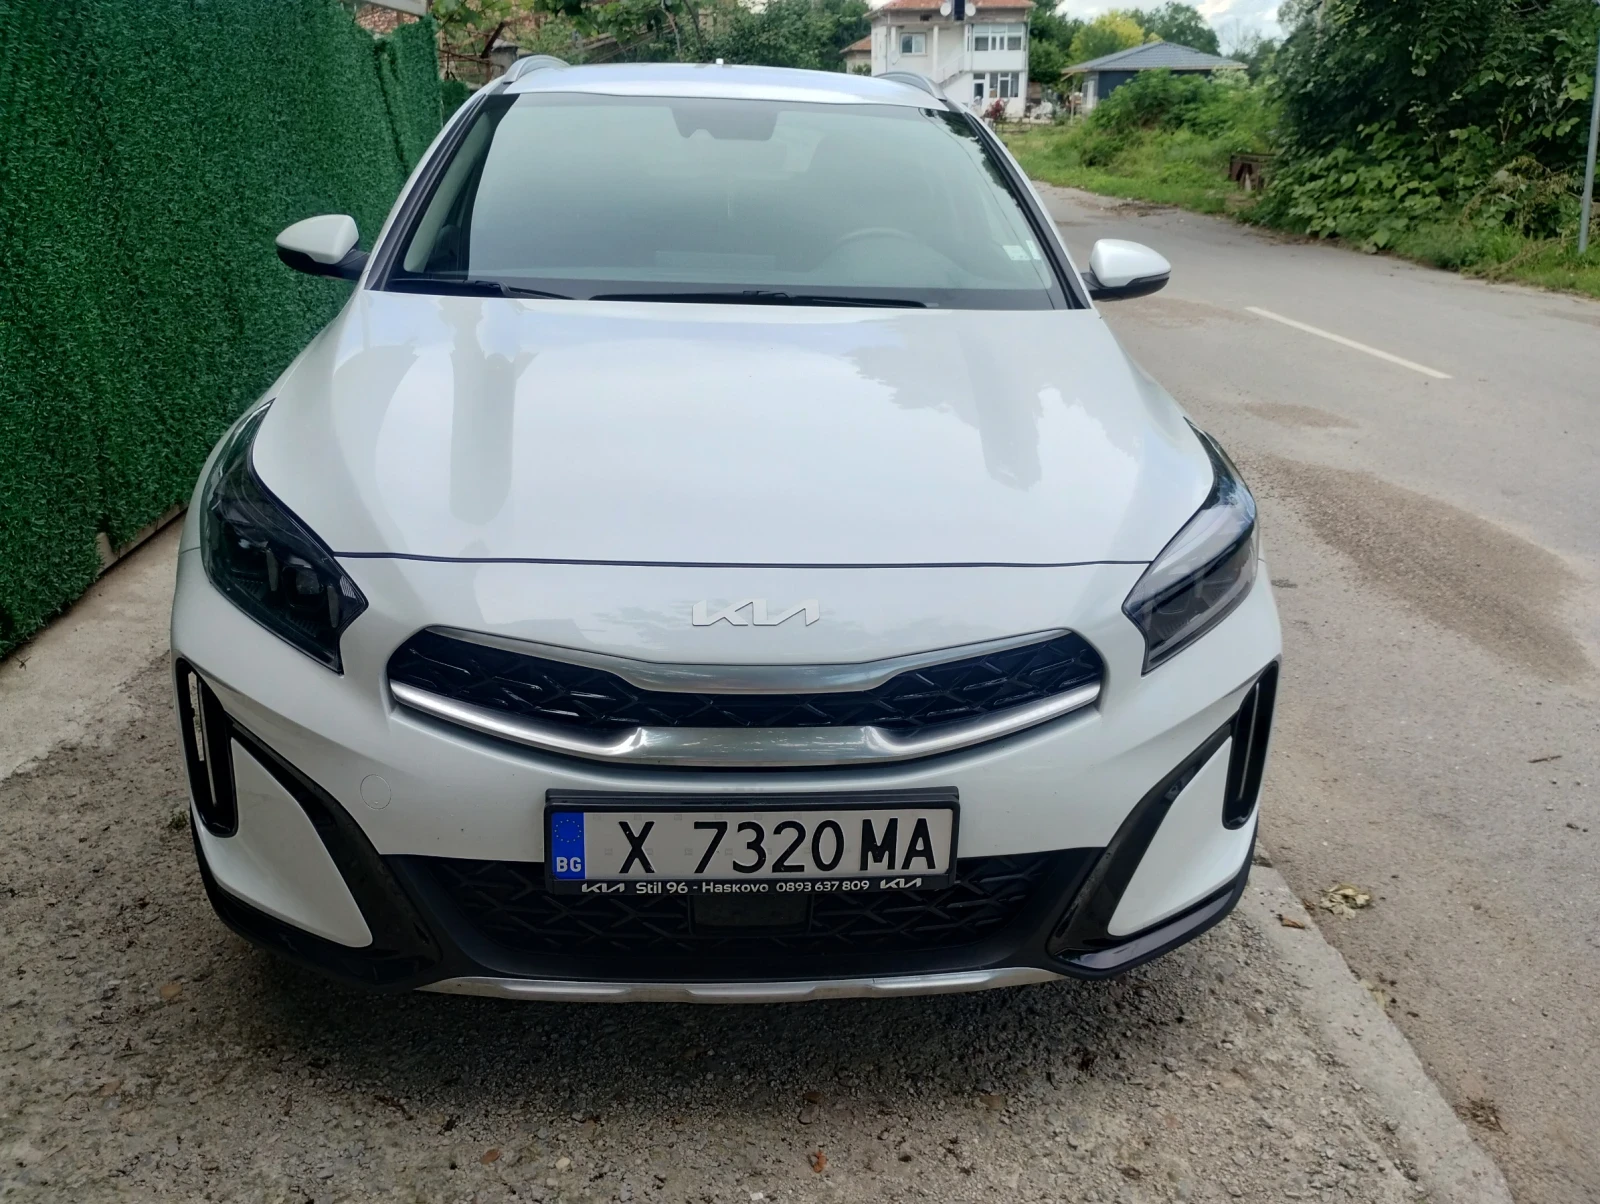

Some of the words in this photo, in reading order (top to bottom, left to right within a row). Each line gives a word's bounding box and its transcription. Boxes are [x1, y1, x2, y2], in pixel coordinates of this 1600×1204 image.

[618, 820, 656, 874] X
[693, 819, 845, 874] 7320
[859, 817, 937, 871] MA
[556, 857, 582, 873] BG
[635, 881, 663, 894] Stil
[666, 881, 688, 894] 96
[701, 881, 769, 893] Haskovo
[776, 881, 812, 892] 0893
[814, 881, 839, 892] 637
[841, 880, 870, 891] 809
